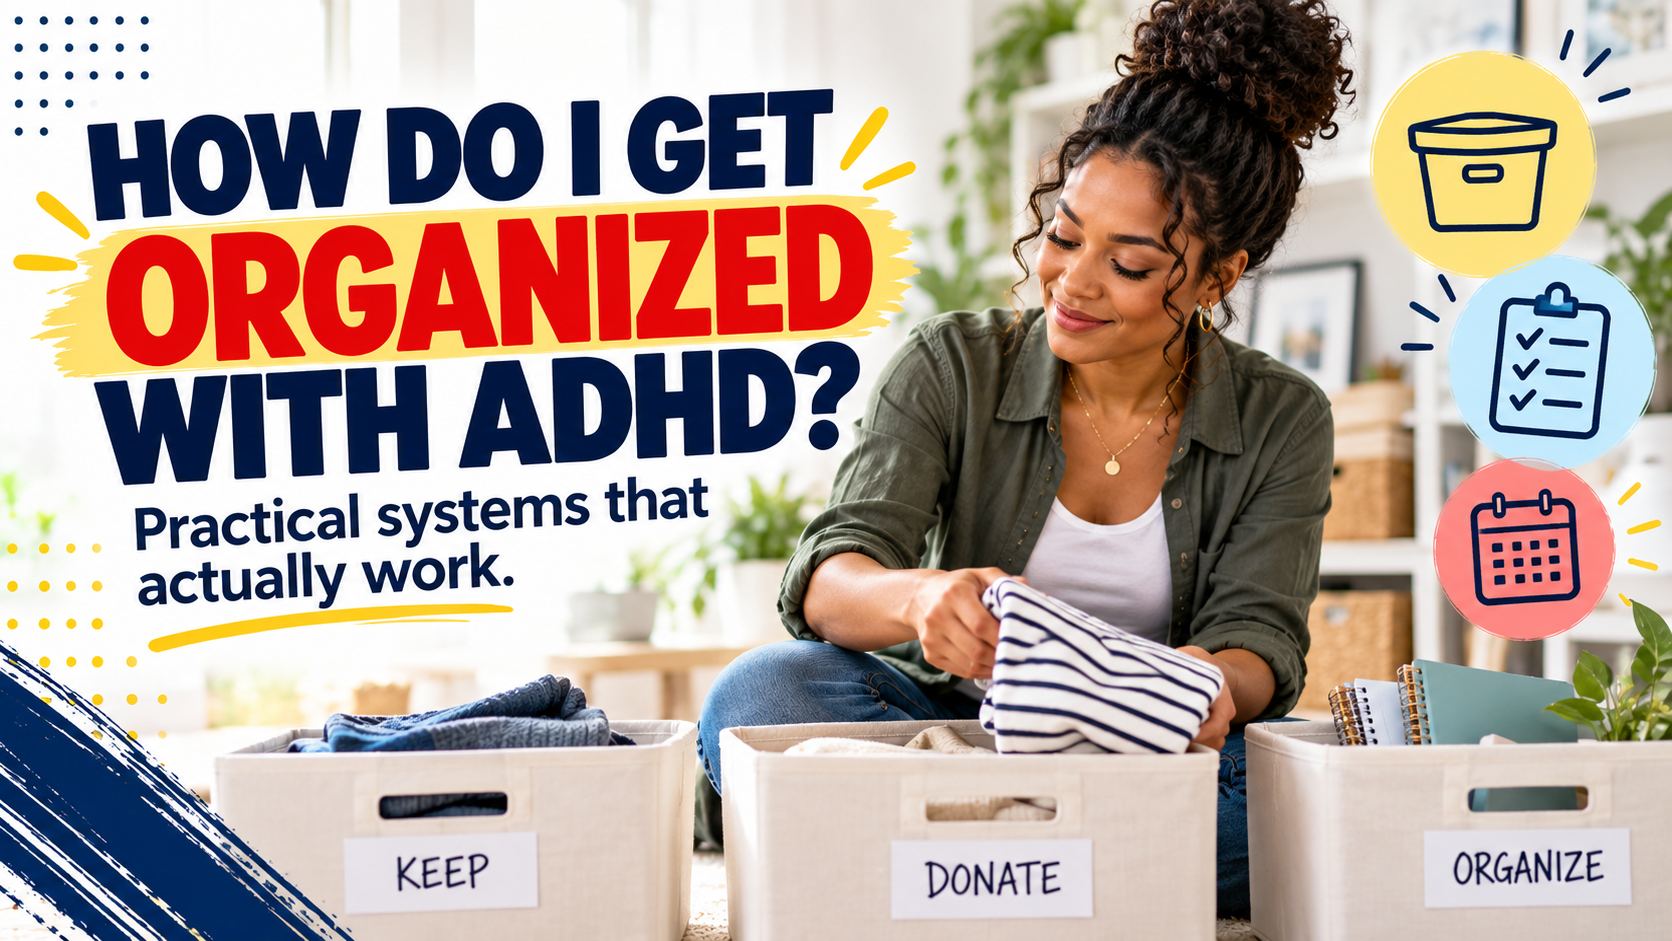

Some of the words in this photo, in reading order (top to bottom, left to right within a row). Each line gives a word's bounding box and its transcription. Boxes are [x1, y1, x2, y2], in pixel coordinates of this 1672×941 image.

[396, 853, 490, 892] KEEP
[925, 860, 1062, 899] DONATE
[1453, 849, 1605, 885] ORGANIZE
